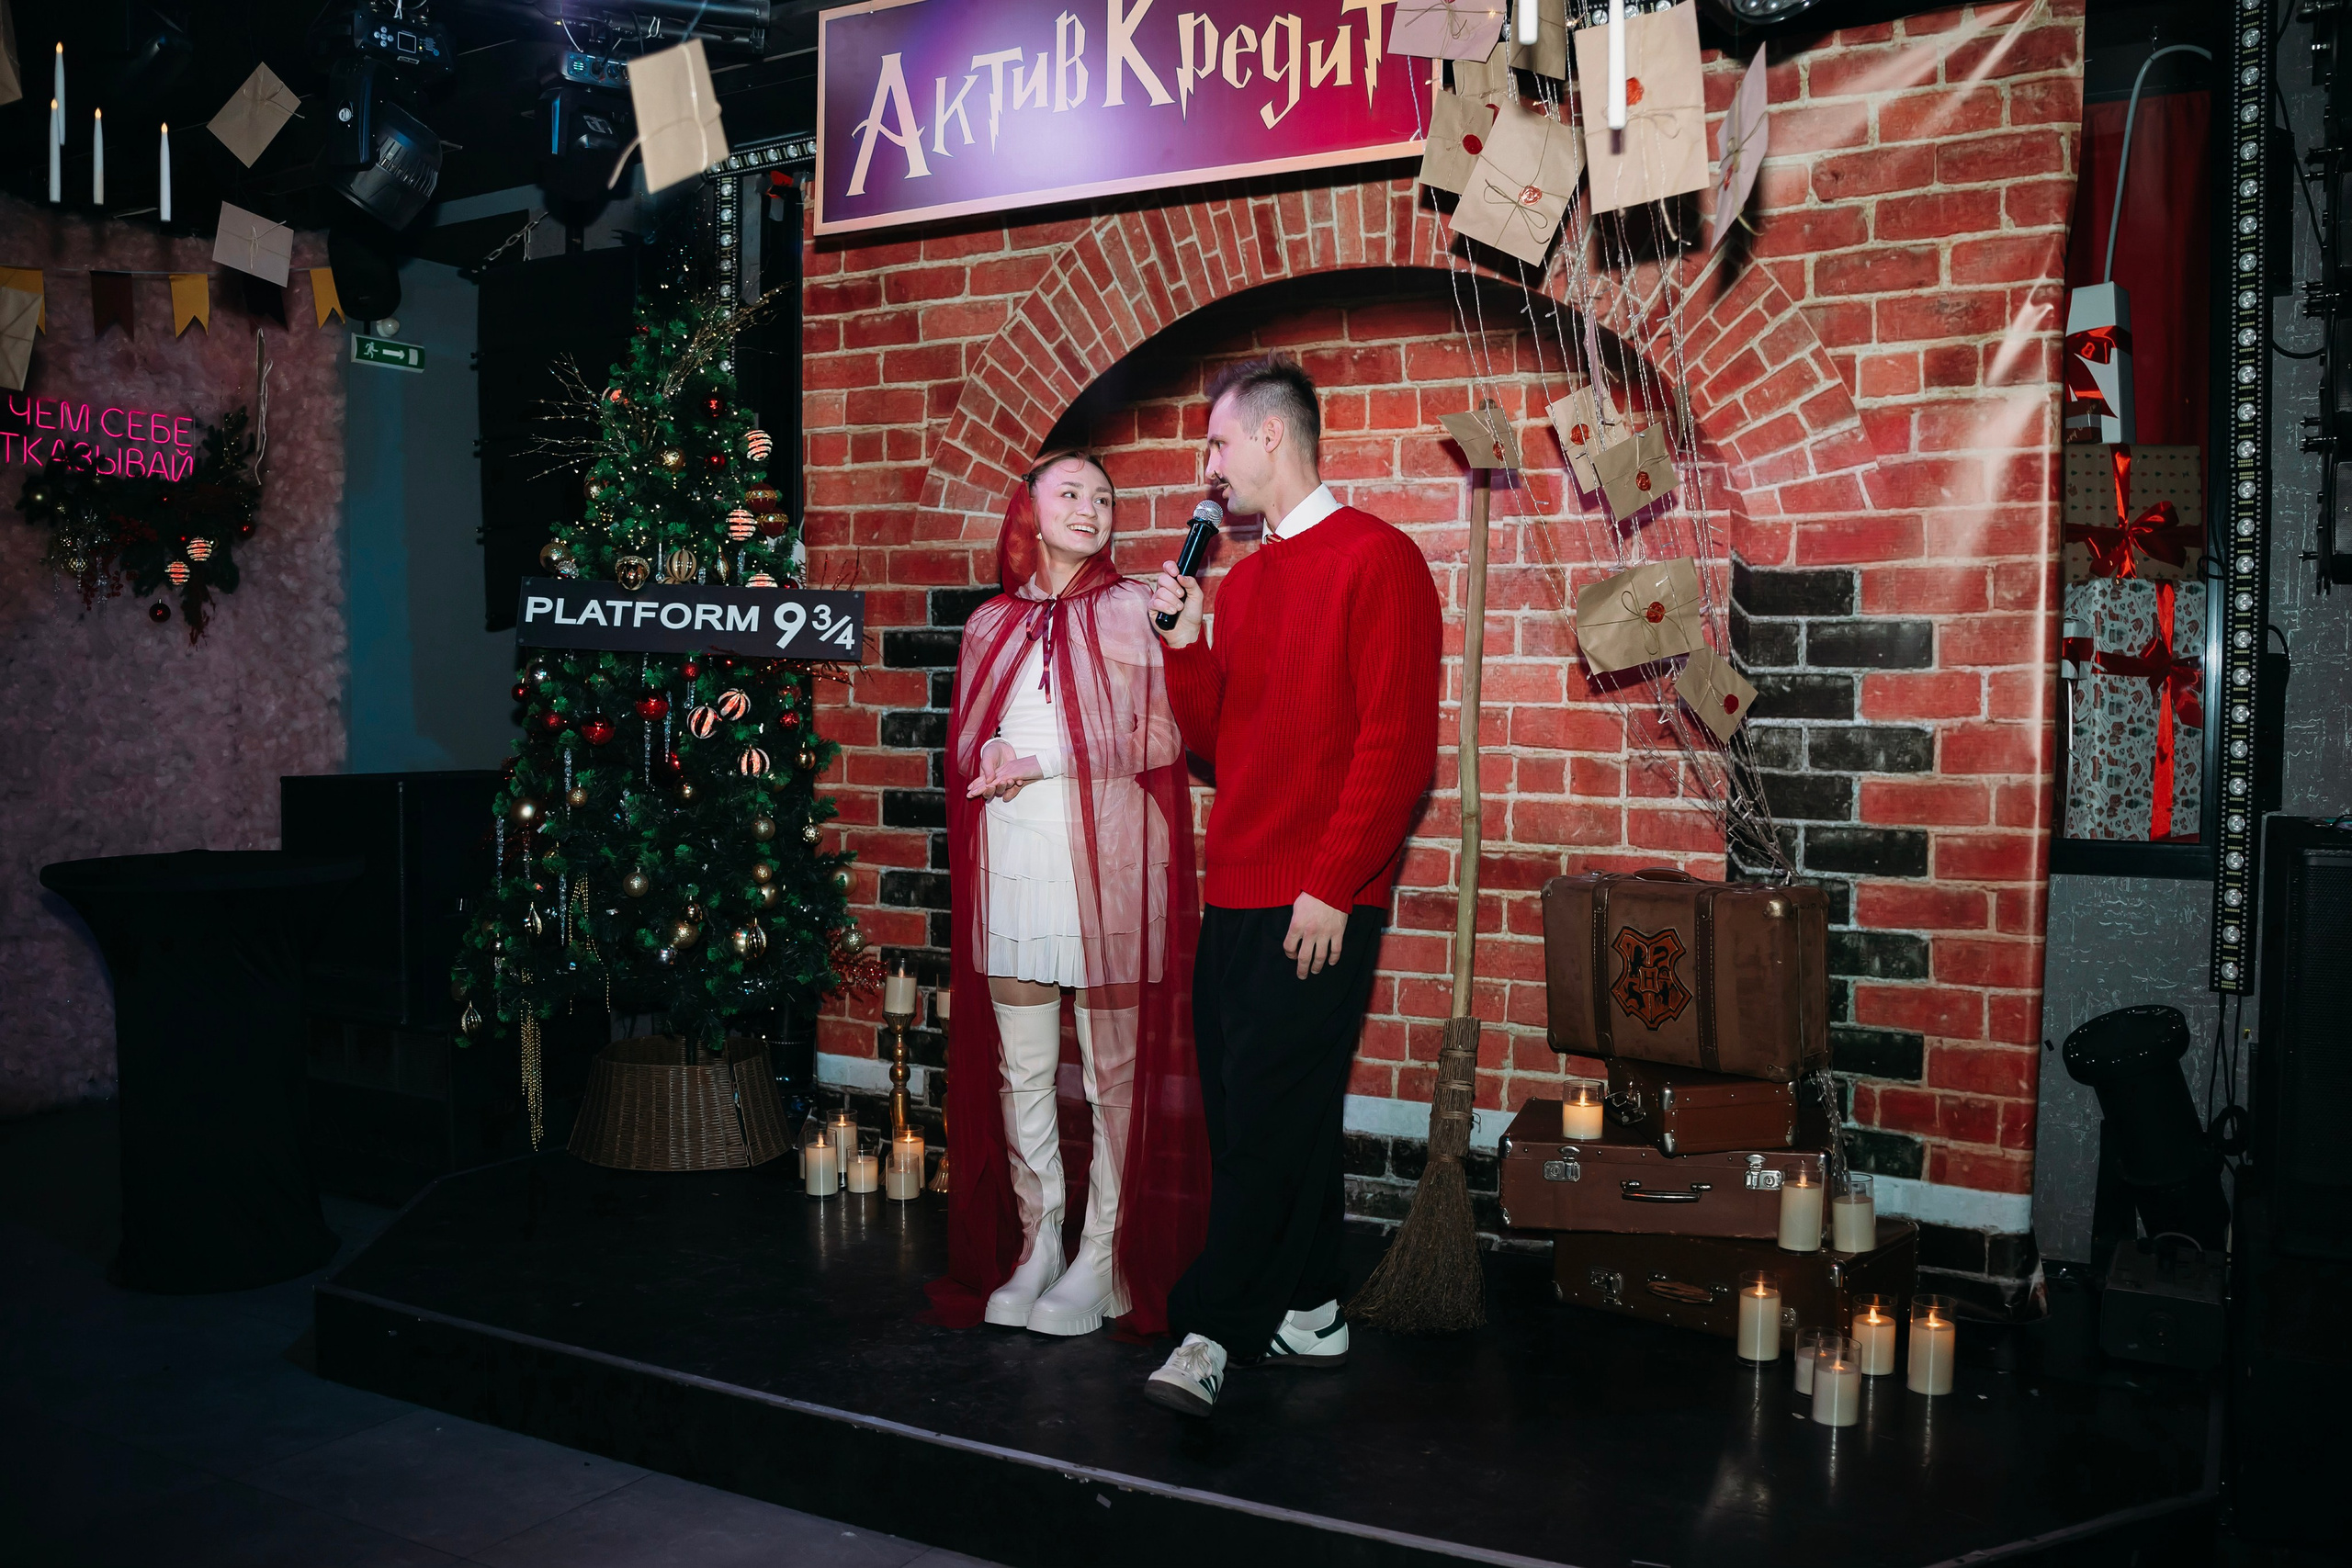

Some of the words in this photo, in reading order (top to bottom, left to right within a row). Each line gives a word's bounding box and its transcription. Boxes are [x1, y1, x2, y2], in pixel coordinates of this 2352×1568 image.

[9, 395, 90, 434] ЧЕМ
[100, 407, 193, 447] СЕБЕ
[525, 596, 761, 632] PLATFORM
[1644, 970, 1654, 988] H
